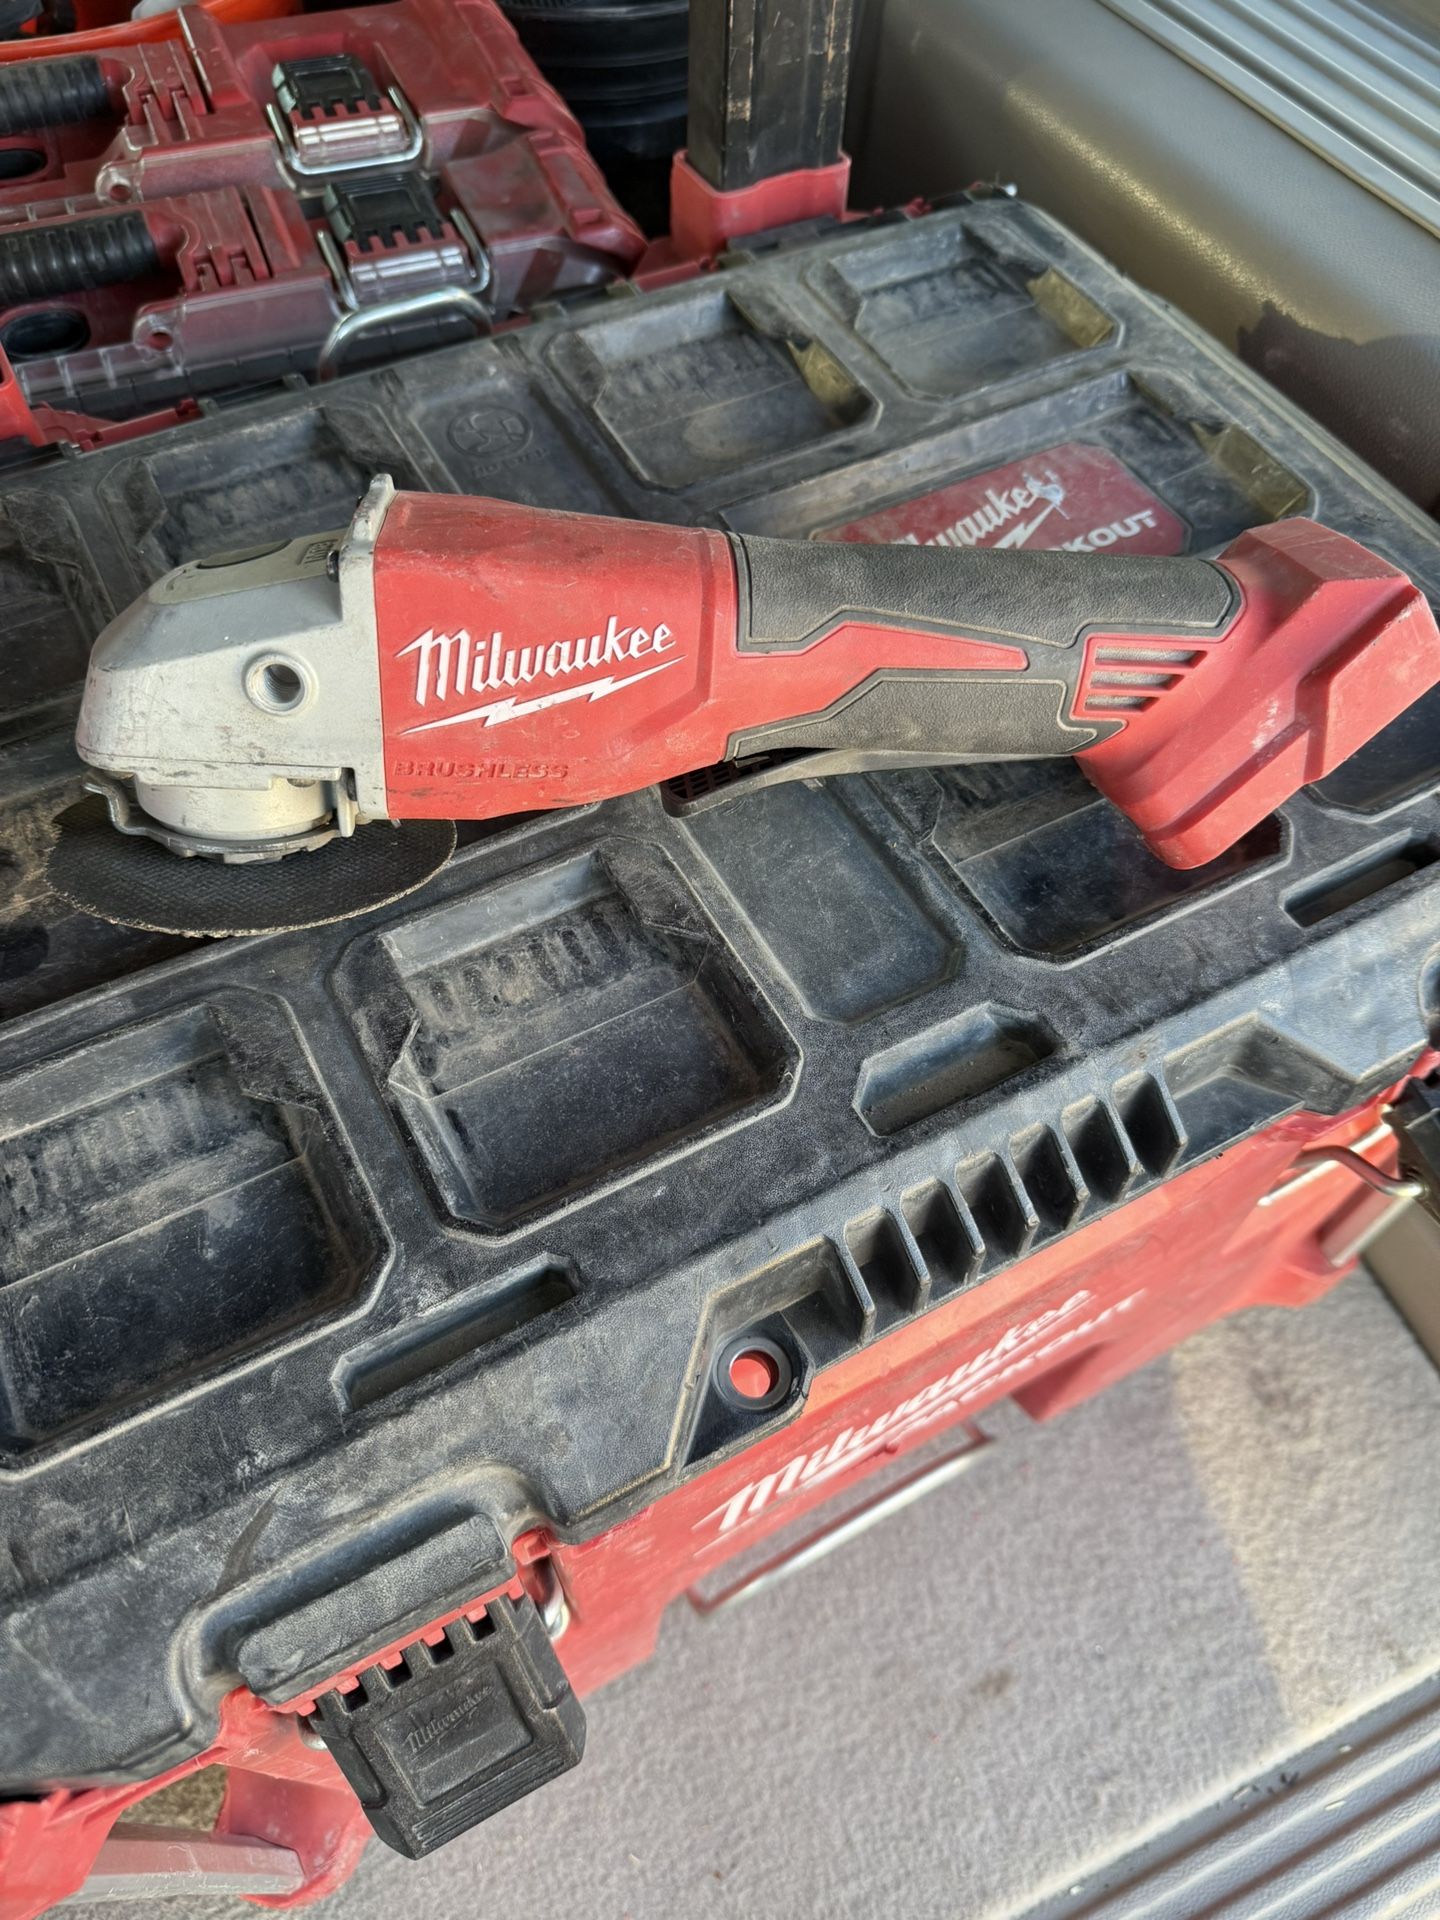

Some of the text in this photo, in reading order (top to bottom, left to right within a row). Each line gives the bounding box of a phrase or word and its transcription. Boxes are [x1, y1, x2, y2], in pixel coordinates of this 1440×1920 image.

[1046, 508, 1157, 552] KOUT
[395, 615, 677, 706] Milwaukee
[393, 759, 569, 779] BRUSHLESS
[691, 1289, 1092, 1532] Milwaukee
